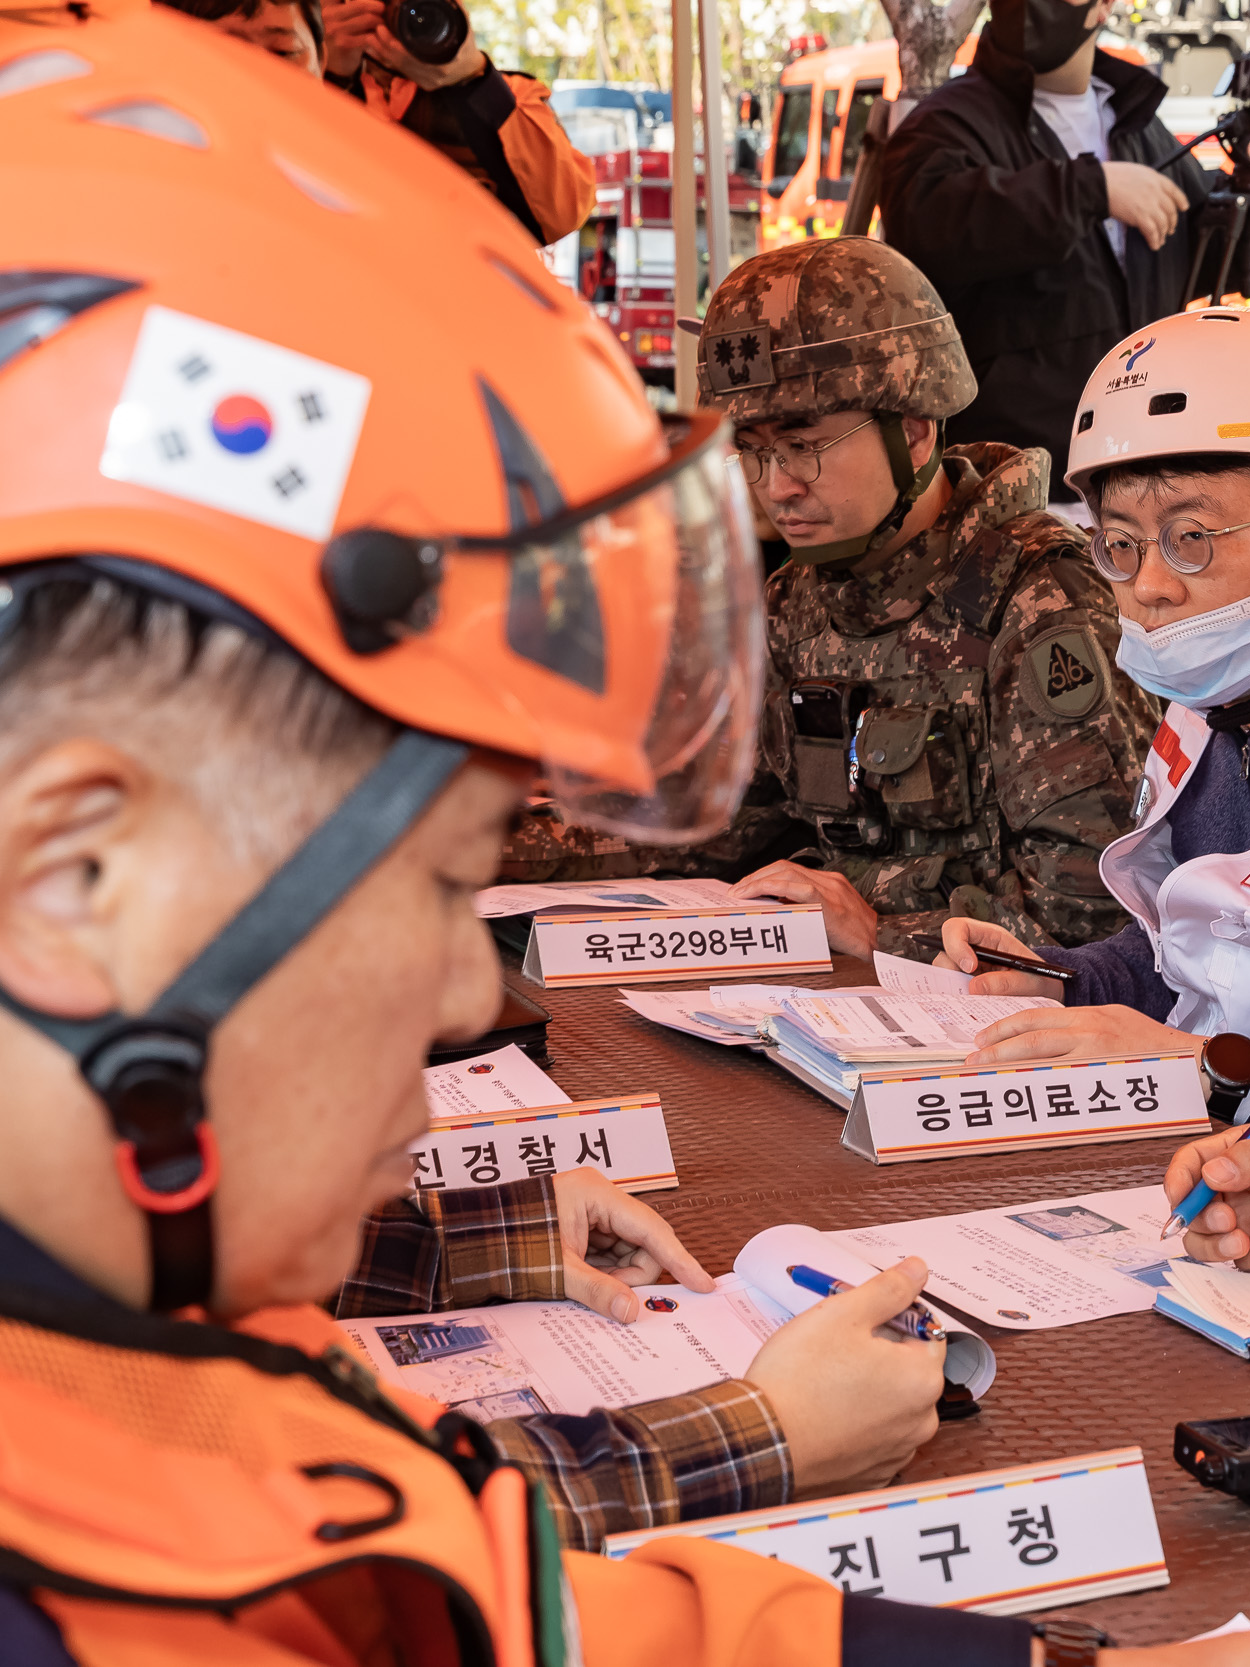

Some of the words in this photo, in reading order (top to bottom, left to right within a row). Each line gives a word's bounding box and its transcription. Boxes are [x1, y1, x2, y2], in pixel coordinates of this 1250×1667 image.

[584, 924, 789, 963] 육군3298부대
[916, 1074, 1160, 1132] 응급의료소장
[768, 1504, 1059, 1597] 진구청
